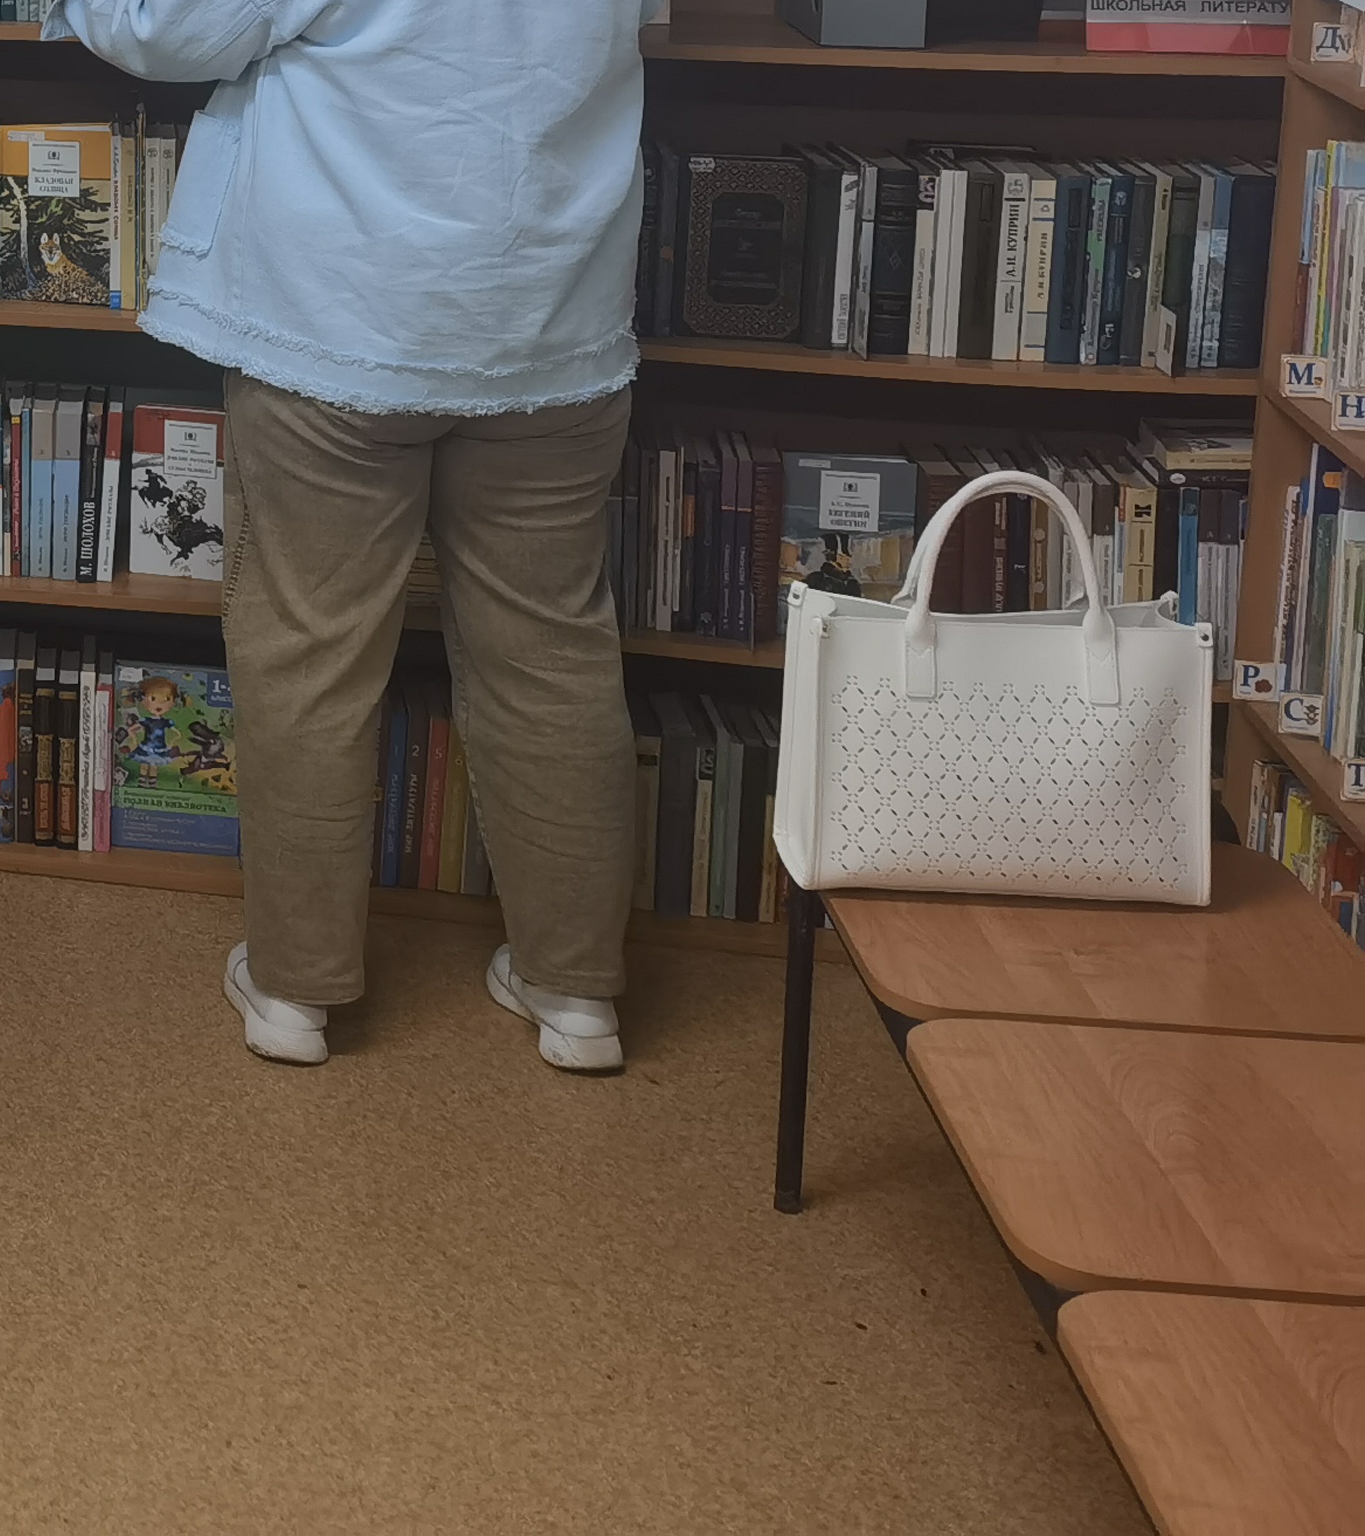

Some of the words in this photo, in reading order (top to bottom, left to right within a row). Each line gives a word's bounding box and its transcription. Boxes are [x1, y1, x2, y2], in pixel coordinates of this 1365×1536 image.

[1090, 0, 1186, 13] ШКОЛЬНАЯ
[1200, 1, 1290, 14] ЛИТЕРАТУ
[1006, 204, 1020, 252] КУПРИН
[1005, 255, 1017, 277] А.И.
[1286, 363, 1315, 385] М
[81, 501, 95, 560] ШОЛОХОВ
[80, 563, 93, 576] М.
[1241, 665, 1260, 687] Р
[1284, 698, 1304, 721] С
[412, 745, 419, 756] 2
